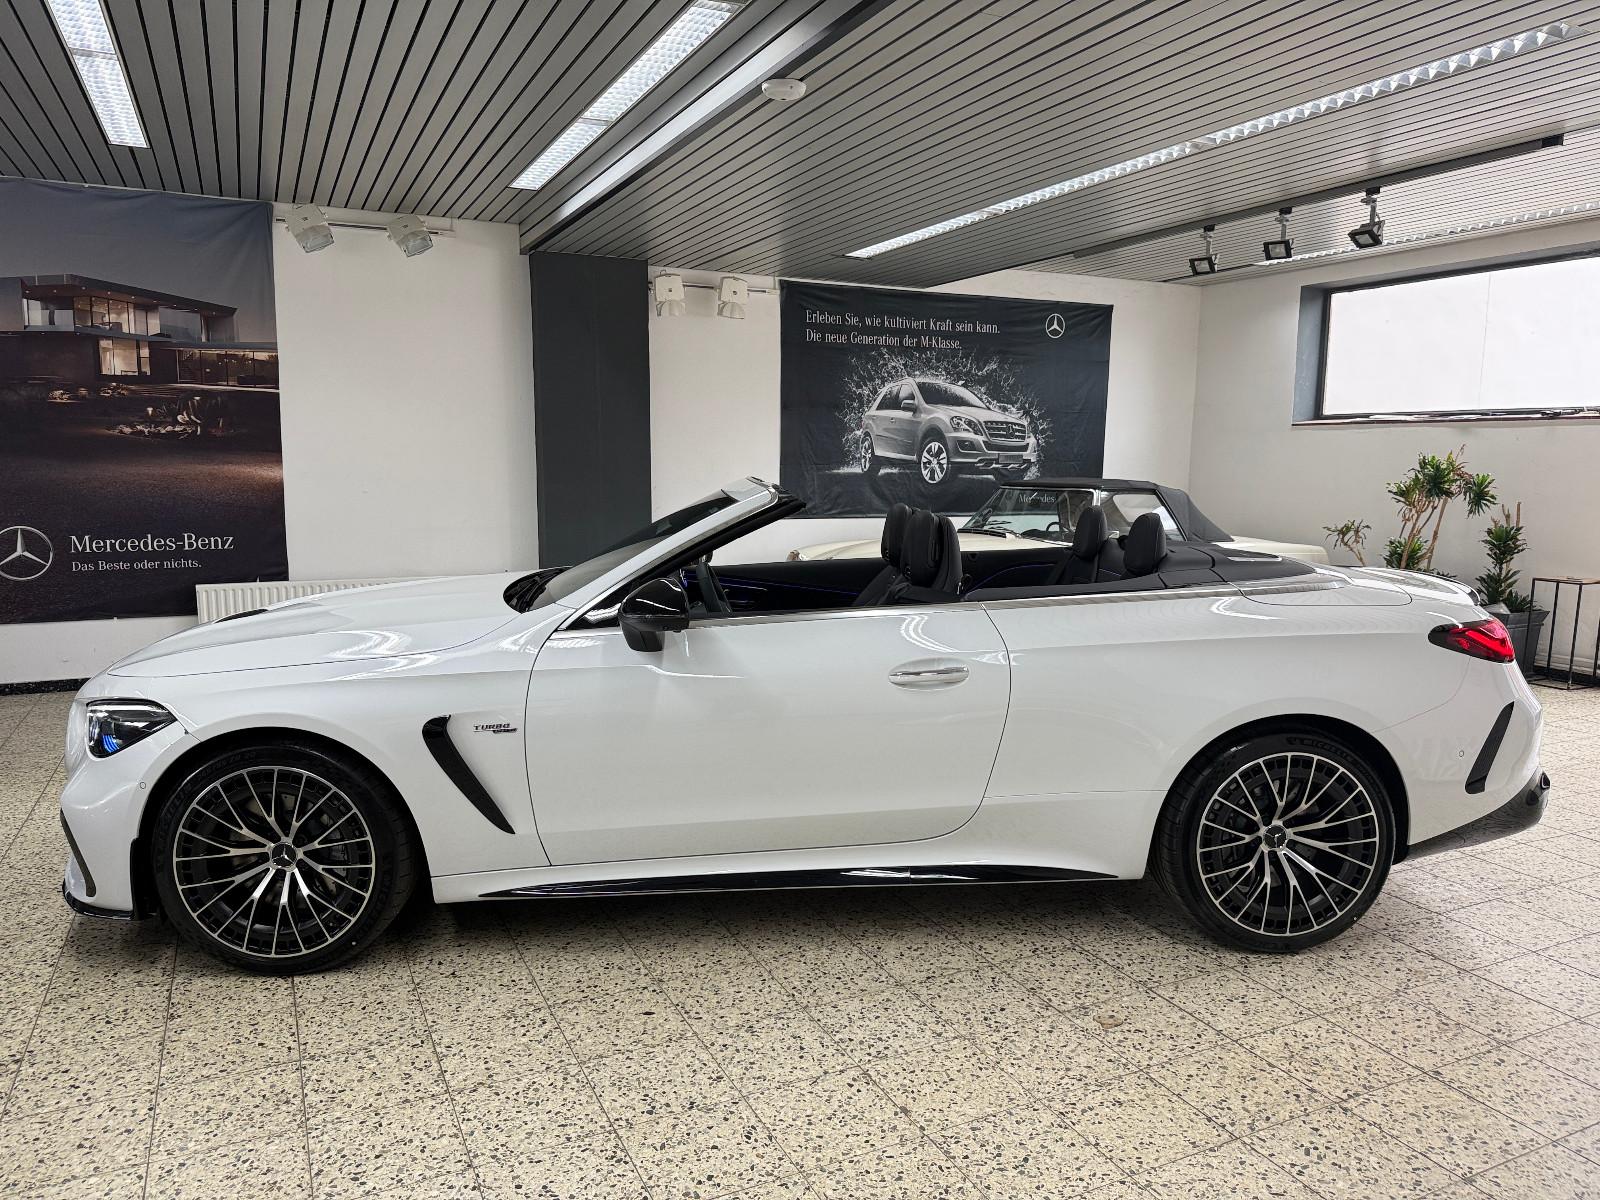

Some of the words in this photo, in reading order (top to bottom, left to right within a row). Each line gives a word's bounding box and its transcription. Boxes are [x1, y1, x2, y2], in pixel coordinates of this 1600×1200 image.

[806, 310, 842, 325] Erleben
[845, 312, 862, 327] Sie,
[865, 315, 881, 327] wie
[884, 315, 927, 330] kultiviert
[930, 318, 953, 331] Kraft
[955, 321, 973, 332] sein
[976, 321, 1000, 334] kann.
[806, 329, 822, 342] Die
[825, 333, 848, 343] neue
[850, 331, 900, 347] Generation
[903, 335, 918, 347] der
[920, 336, 962, 350] M-Klasse.
[69, 533, 234, 553] Mercedes-Benz
[72, 560, 94, 571] Das
[98, 560, 130, 571] Beste
[133, 559, 160, 570] oder
[163, 557, 202, 569] nichts.
